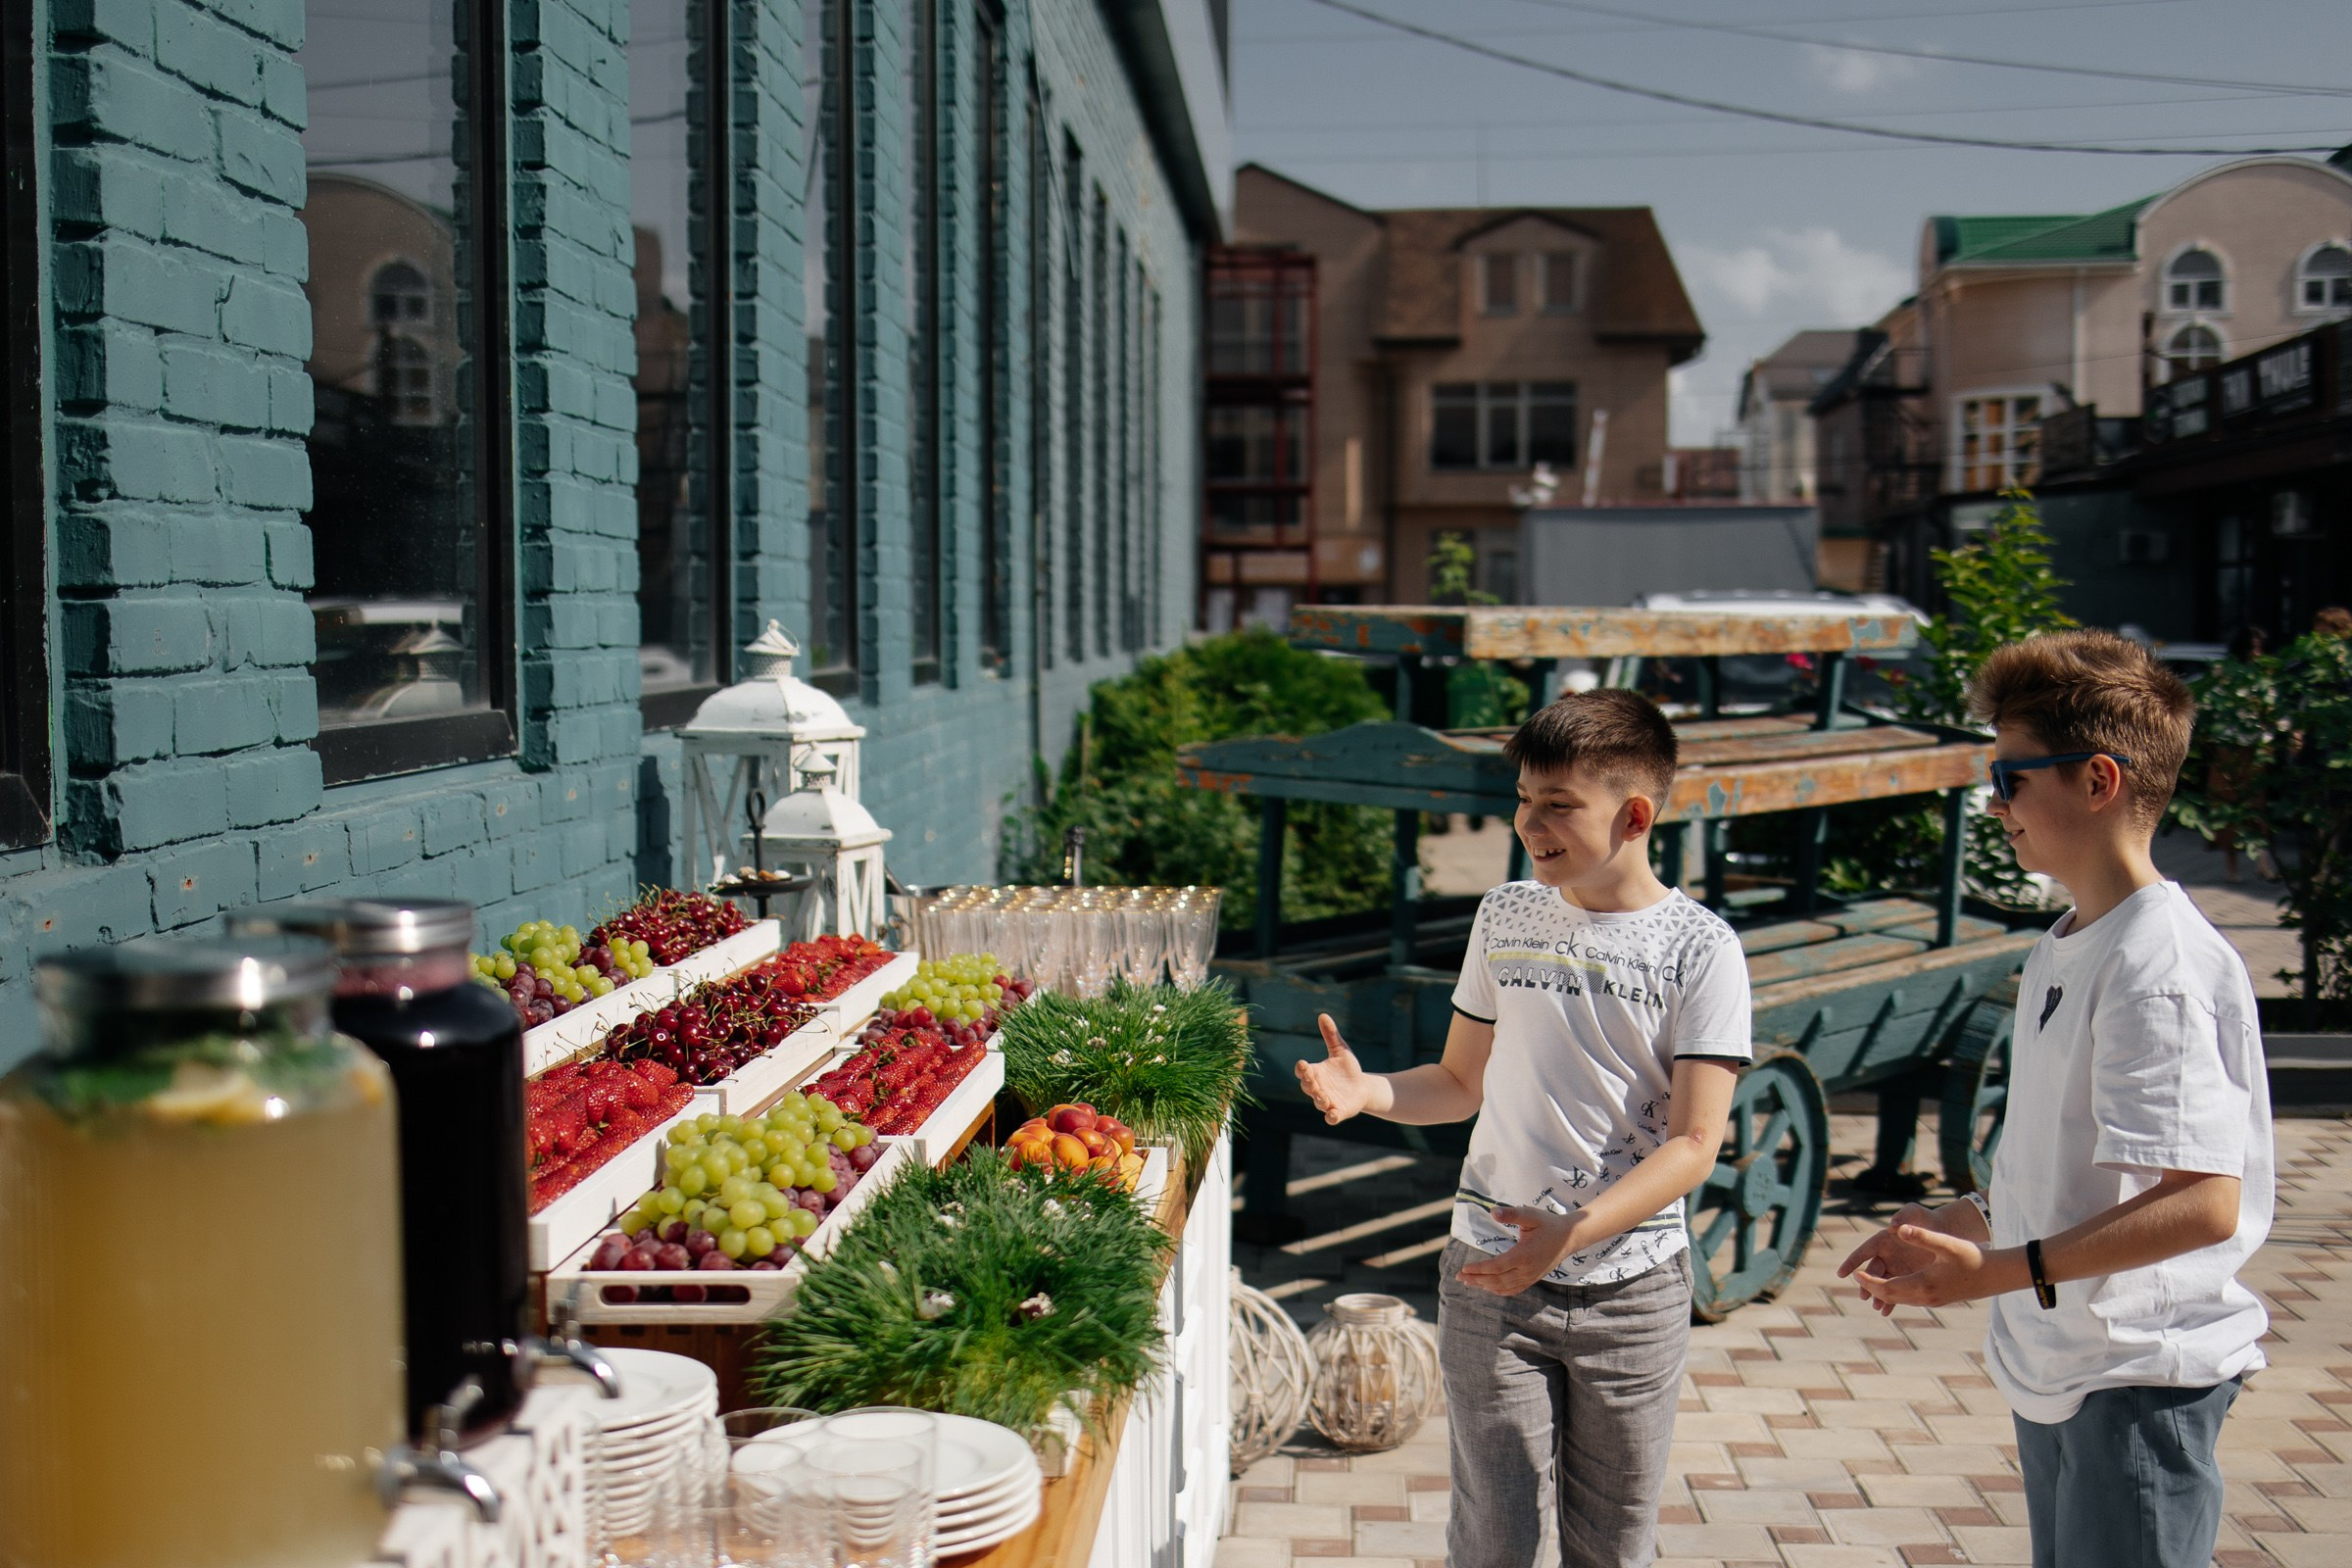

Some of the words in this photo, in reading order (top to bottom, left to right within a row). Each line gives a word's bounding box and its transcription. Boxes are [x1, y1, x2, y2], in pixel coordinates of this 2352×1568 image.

[1490, 937, 1521, 950] Calvin
[1522, 937, 1549, 950] Klein
[1585, 946, 1626, 966] Calvin
[1626, 957, 1657, 974] Klein
[1497, 966, 1583, 996] CALVIN
[1603, 979, 1663, 1009] KLEIN
[1595, 1246, 1613, 1260] Calvin
[1610, 1235, 1625, 1248] Klein
